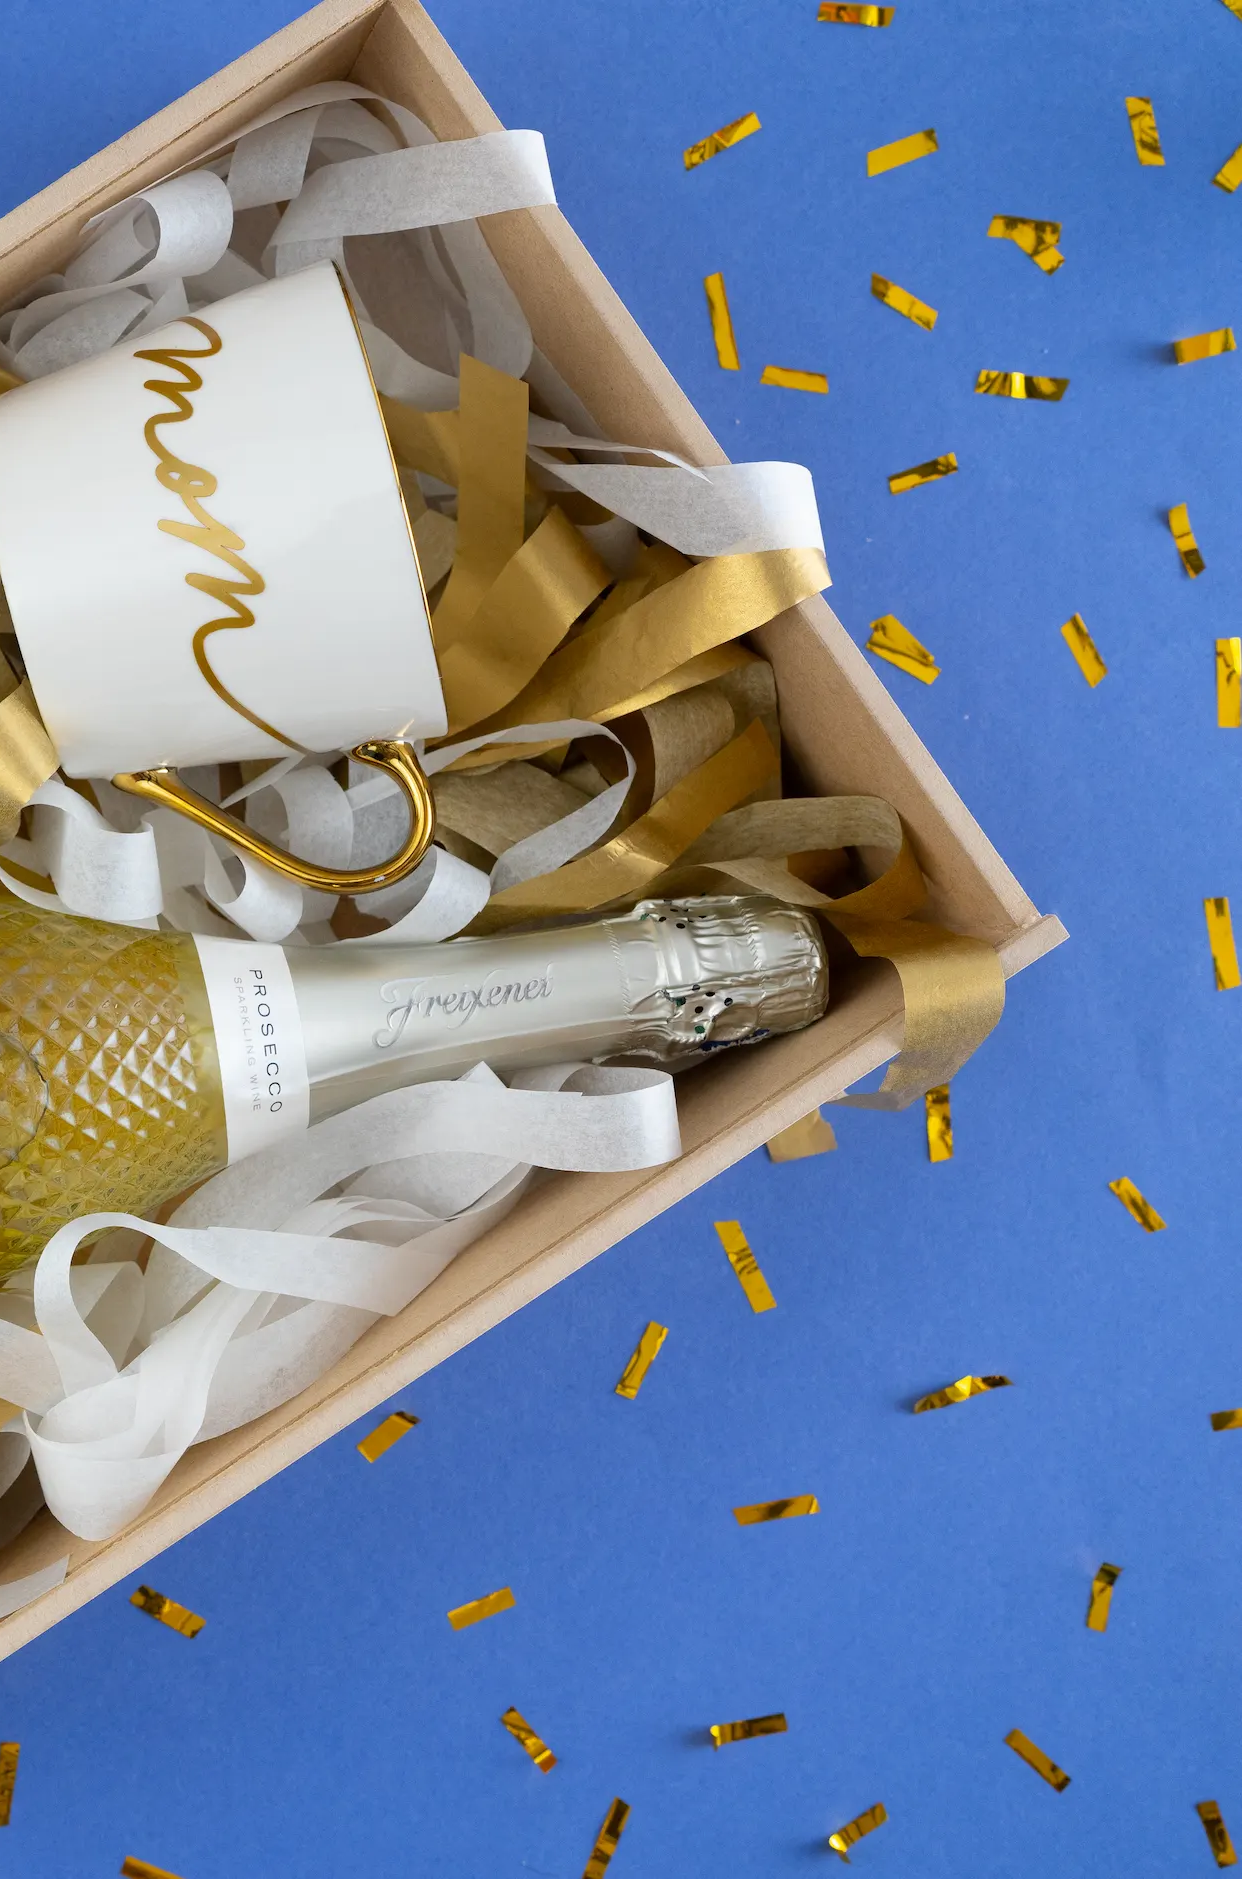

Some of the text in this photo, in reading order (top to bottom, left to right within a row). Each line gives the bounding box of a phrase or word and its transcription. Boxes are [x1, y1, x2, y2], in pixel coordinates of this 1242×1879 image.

[134, 317, 311, 751] mom
[234, 978, 261, 1111] SPARKLING WINE
[250, 970, 283, 1112] PROSECCO
[374, 963, 554, 1048] Freixenet
